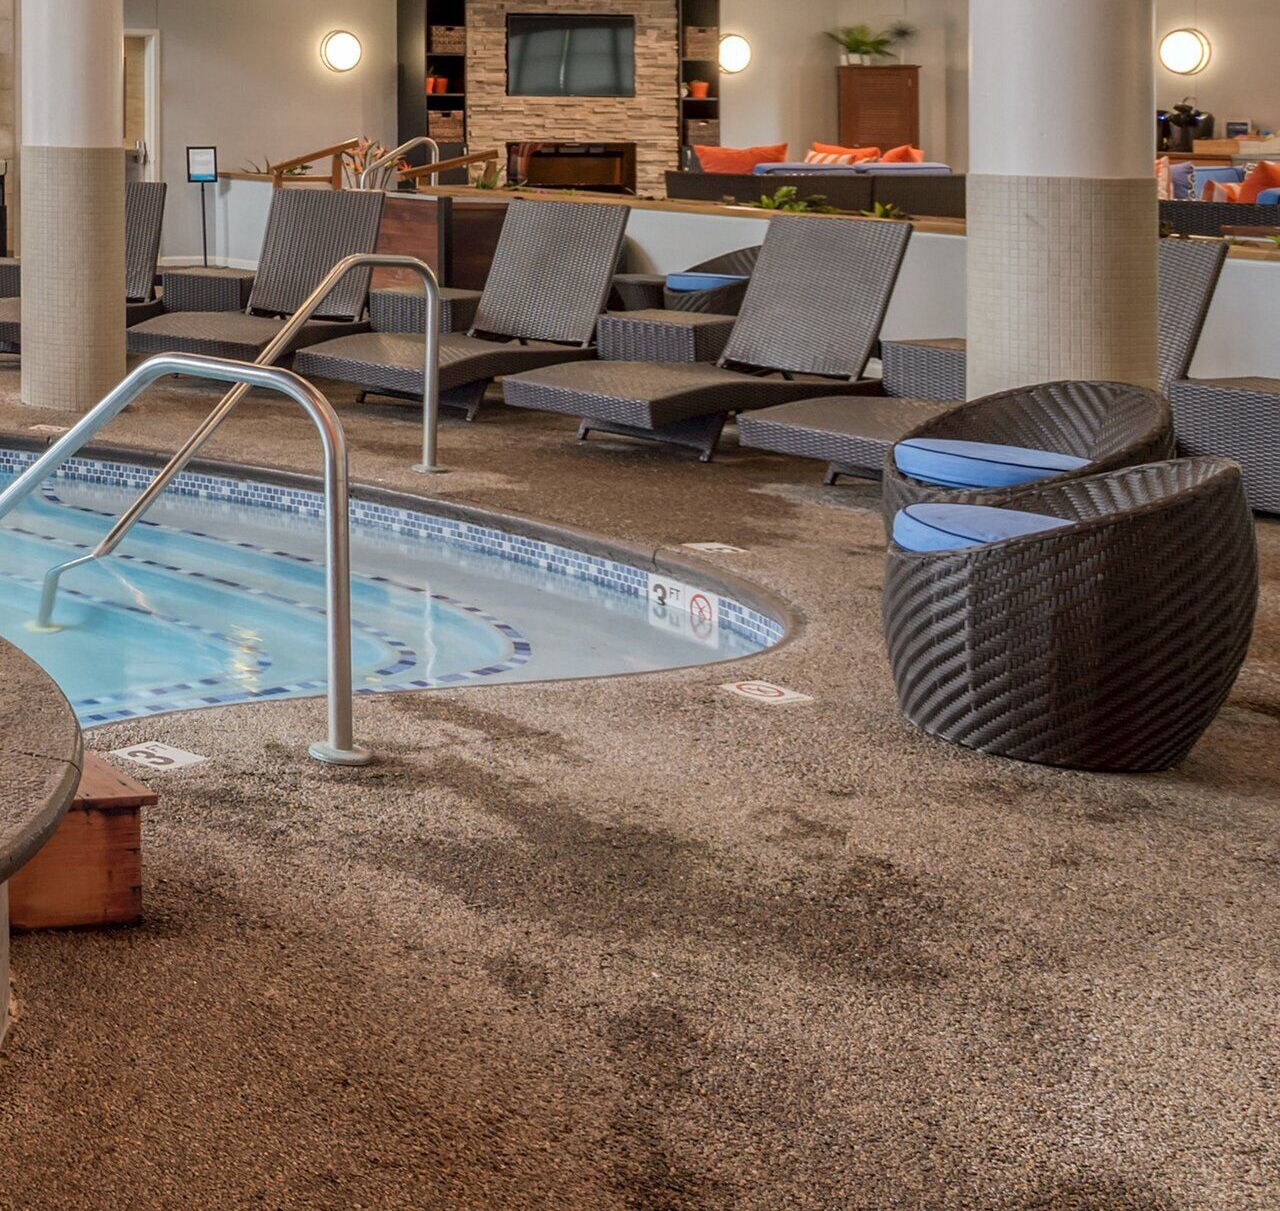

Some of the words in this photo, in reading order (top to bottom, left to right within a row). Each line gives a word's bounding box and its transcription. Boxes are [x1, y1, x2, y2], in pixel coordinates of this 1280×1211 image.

[652, 583, 667, 607] 3
[669, 587, 680, 601] FT
[127, 750, 175, 765] 3
